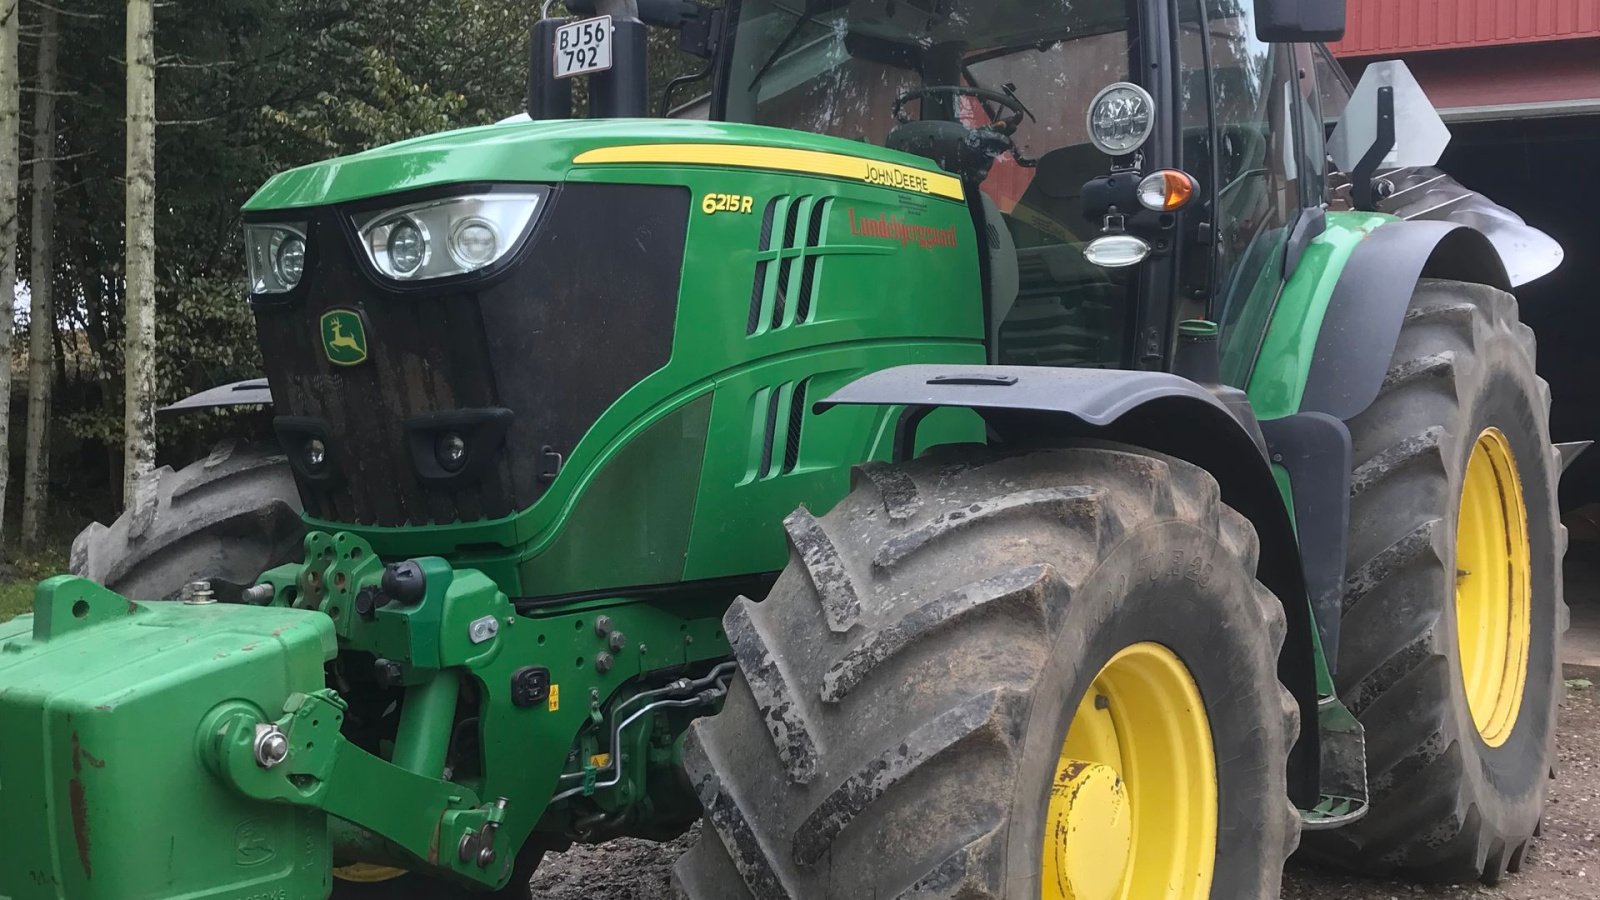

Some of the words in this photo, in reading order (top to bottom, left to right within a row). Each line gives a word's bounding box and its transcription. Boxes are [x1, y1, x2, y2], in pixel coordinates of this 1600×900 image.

[565, 46, 598, 72] 792
[864, 163, 894, 186] JOHN
[894, 168, 929, 192] DEERE
